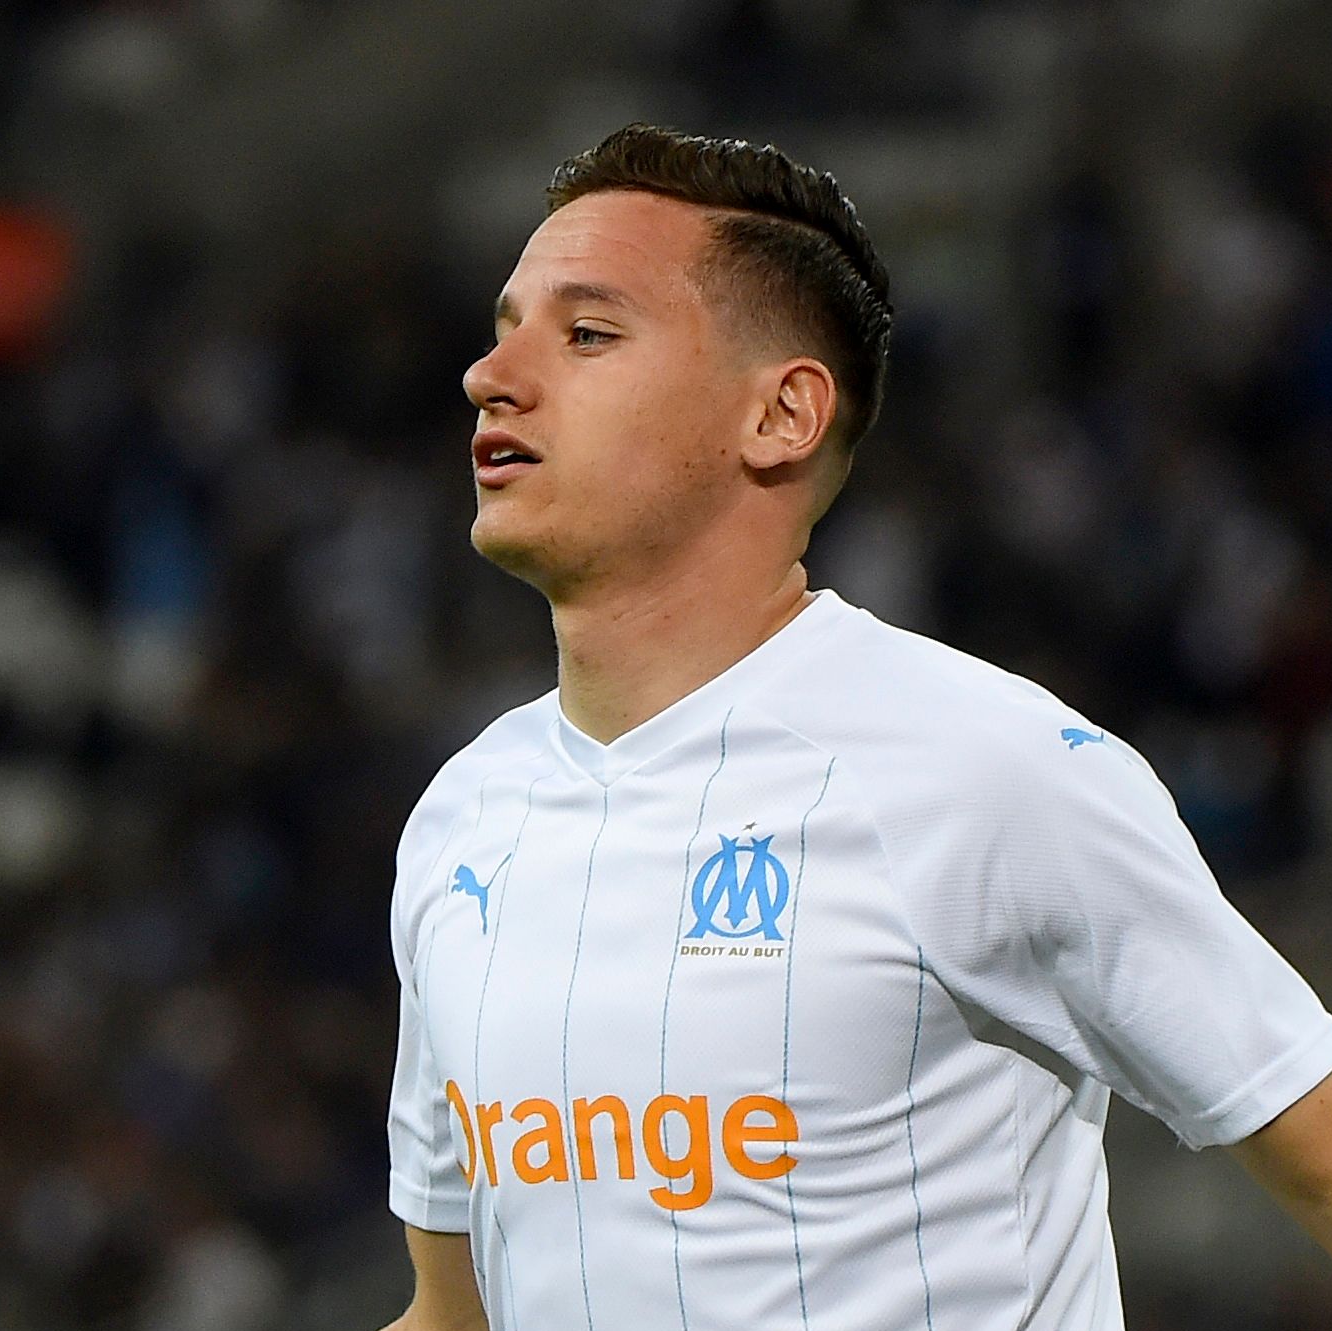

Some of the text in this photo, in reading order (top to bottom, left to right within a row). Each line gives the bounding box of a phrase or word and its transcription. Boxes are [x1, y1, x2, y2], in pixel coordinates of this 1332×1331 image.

[680, 945, 785, 958] DROIT AU BUT
